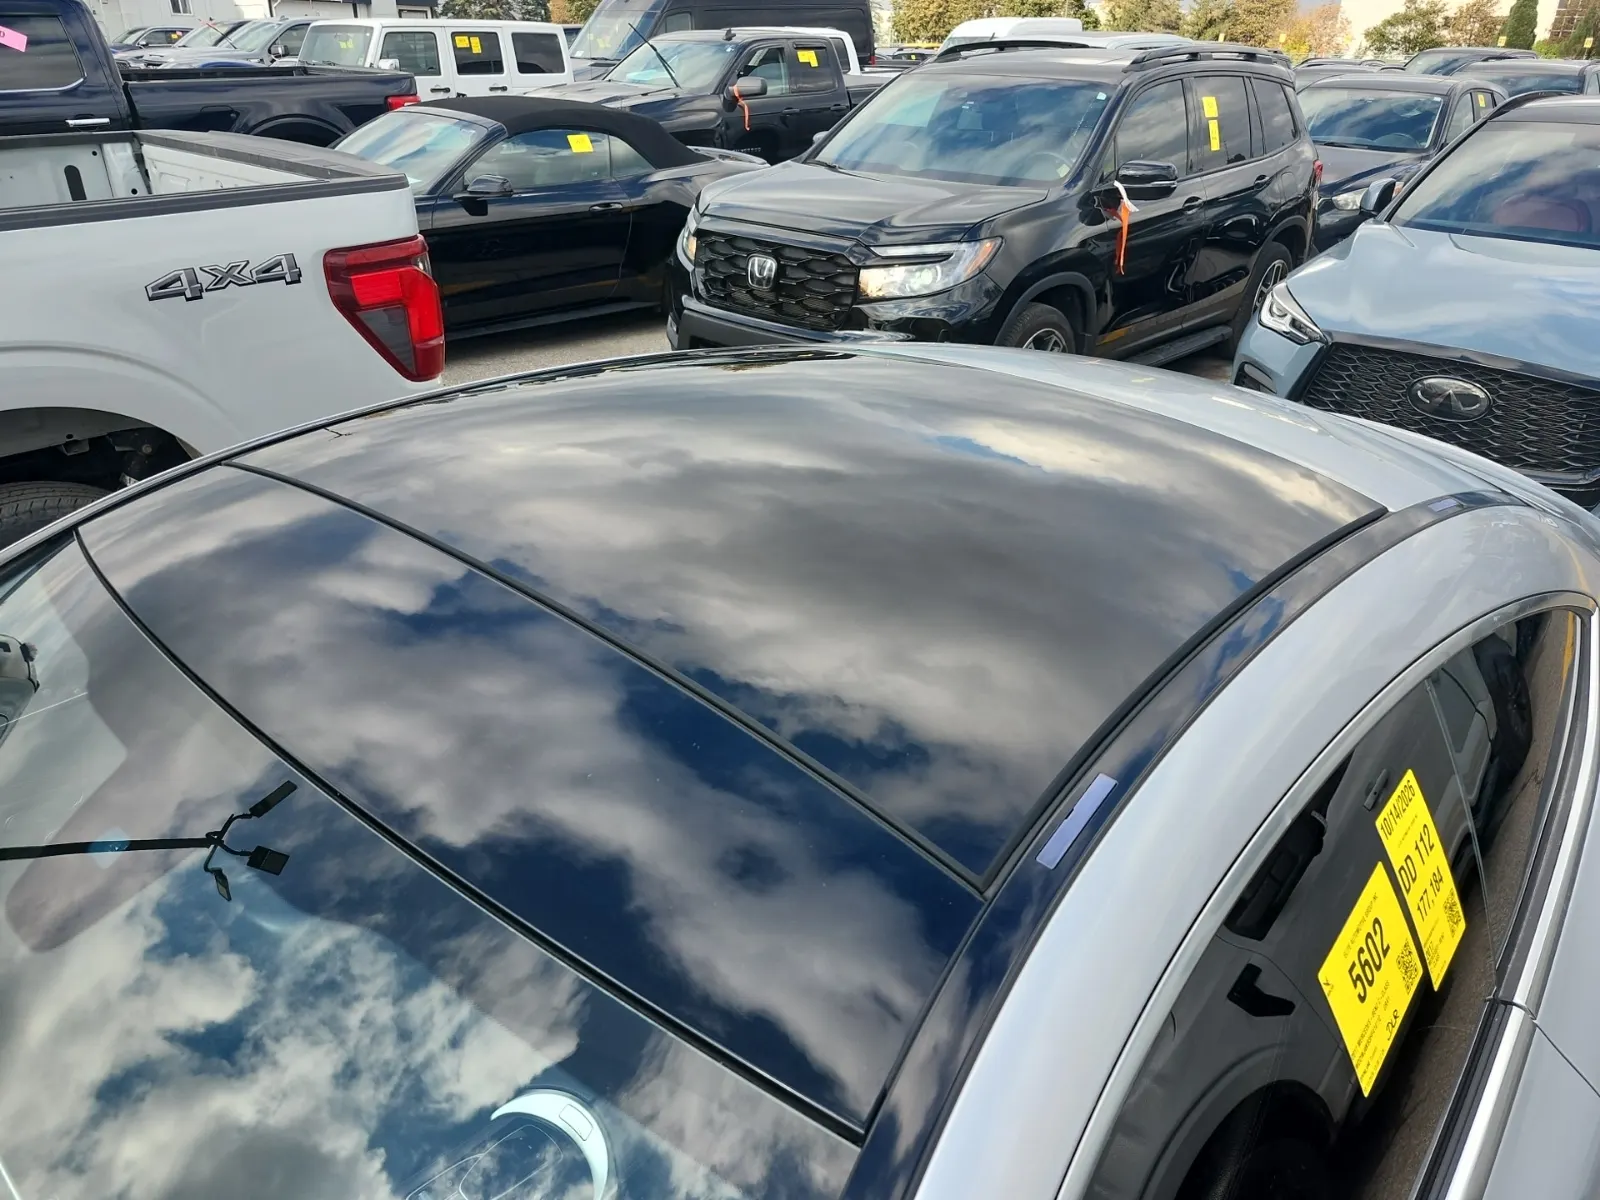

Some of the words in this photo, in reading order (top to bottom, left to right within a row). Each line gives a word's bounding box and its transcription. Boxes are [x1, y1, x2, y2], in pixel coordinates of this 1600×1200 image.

[1380, 779, 1416, 840] 10/14/2026
[1397, 854, 1418, 896] DD
[1414, 823, 1435, 866] 112
[1416, 865, 1444, 922] 177,184
[1347, 916, 1391, 1004] 5602
